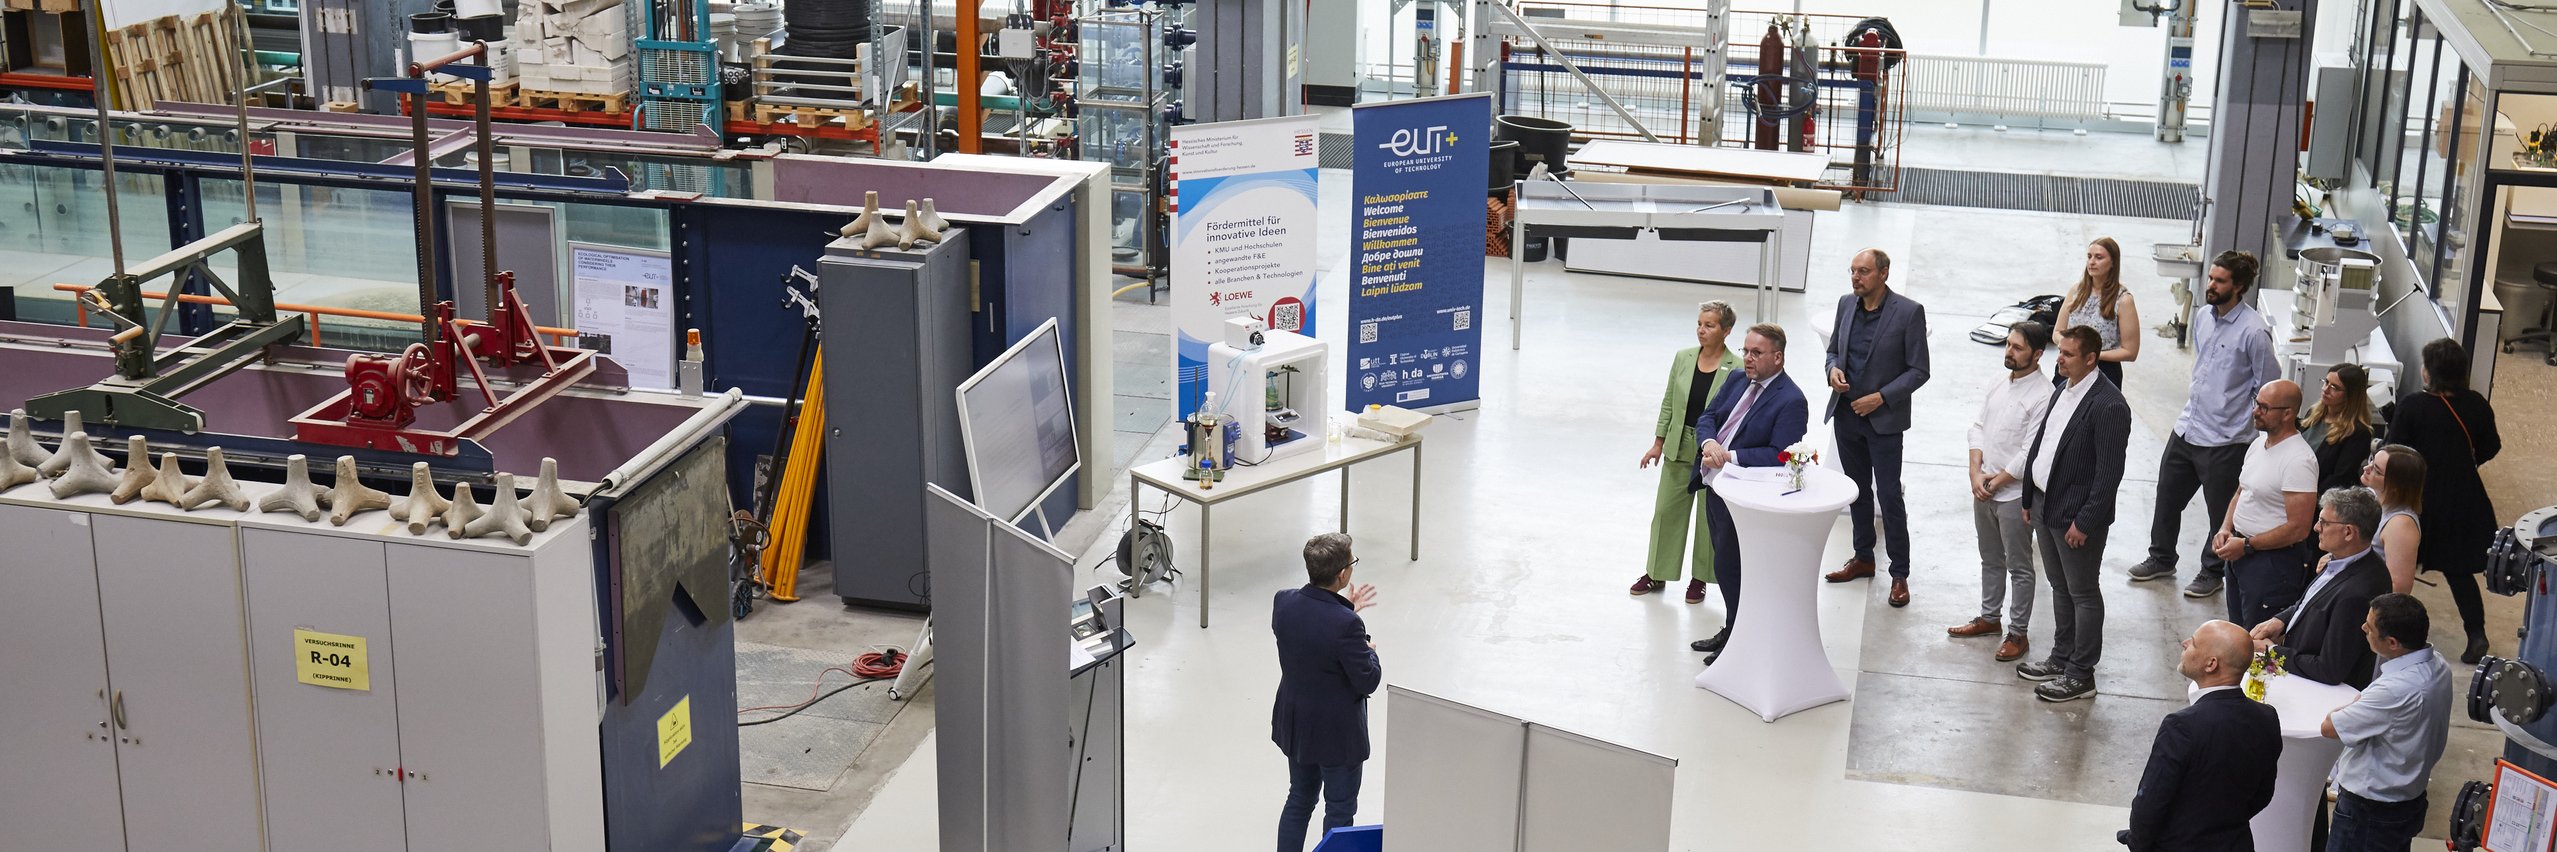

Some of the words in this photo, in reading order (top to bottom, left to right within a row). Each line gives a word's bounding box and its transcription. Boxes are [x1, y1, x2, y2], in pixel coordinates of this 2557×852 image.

[1384, 159, 1413, 167] EUROPEAN
[1416, 155, 1452, 164] UNIVERSITY
[1405, 164, 1441, 172] TECHNOLOGY
[1364, 190, 1428, 204] Καλωσορίσατε
[1364, 205, 1404, 216] Welcome
[1206, 217, 1264, 231] Fördermittel
[1267, 216, 1280, 225] für
[1363, 216, 1409, 228] Bienvenue
[1206, 230, 1255, 242] innovative
[1259, 227, 1286, 237] Ideen
[1363, 225, 1417, 239] Bienvenidos
[1244, 242, 1282, 250] Hochschulen
[1363, 238, 1418, 250] Willkommen
[1215, 256, 1251, 265] angewandte
[1362, 252, 1391, 264] Добре
[1393, 248, 1423, 259] дошли
[1215, 262, 1280, 275] Kooperationsprojekte
[1362, 264, 1382, 274] Bine
[1398, 258, 1420, 269] venit
[1227, 275, 1254, 284] Branchen
[1263, 270, 1303, 280] Technologien
[1362, 271, 1407, 285] Benvenuti
[1224, 291, 1253, 301] LOEWE
[1362, 284, 1389, 297] Laipni
[1402, 368, 1423, 380] h_da
[304, 638, 355, 649] VERSUCHSRINNE
[311, 651, 351, 668] R-04
[313, 673, 352, 683] (KIPPRINNE)
